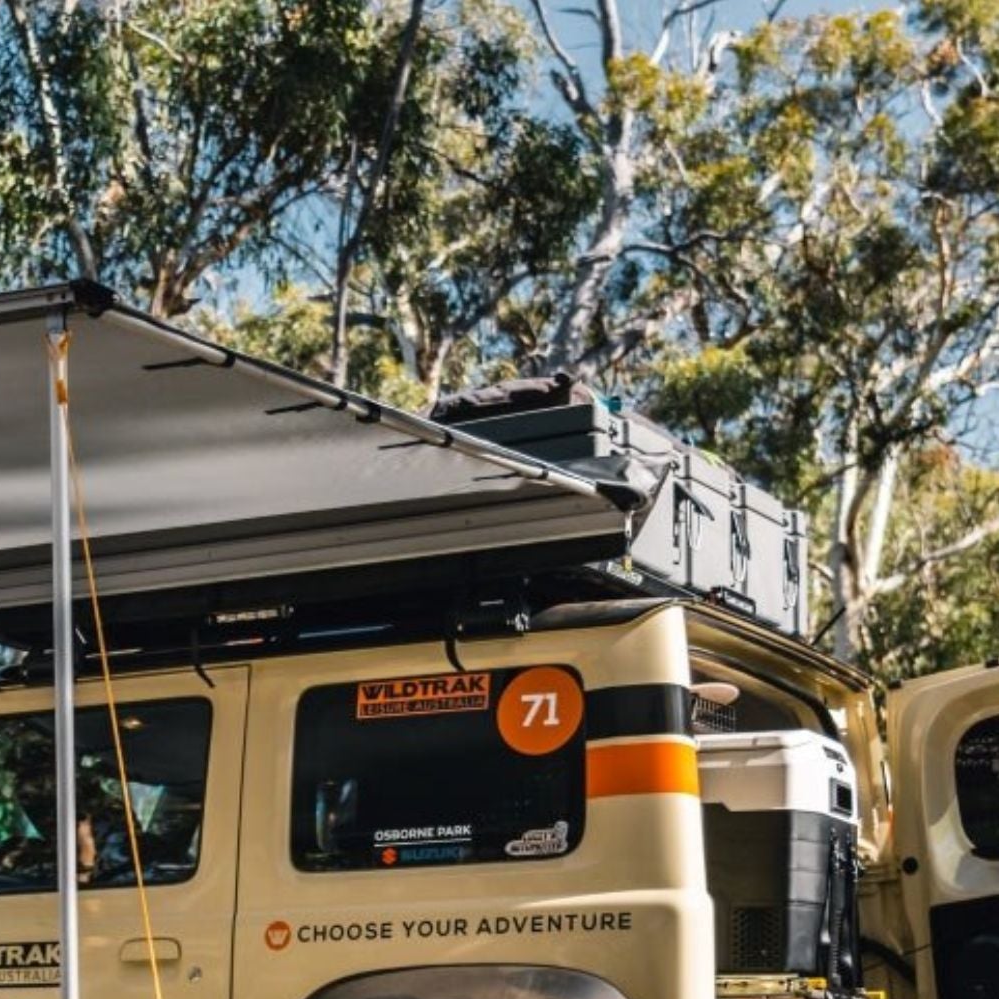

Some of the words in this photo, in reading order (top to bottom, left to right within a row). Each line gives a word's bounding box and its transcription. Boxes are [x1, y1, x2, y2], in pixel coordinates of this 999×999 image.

[361, 675, 485, 699] WILDTRAK
[361, 700, 410, 716] LEISURE
[412, 695, 485, 712] AUSTRALIA
[520, 692, 560, 728] 71
[374, 827, 435, 842] OSBORNE
[437, 824, 472, 838] PARK
[297, 922, 393, 943] CHOOSE
[402, 918, 468, 938] YOUR
[476, 912, 632, 935] ADVENTURE
